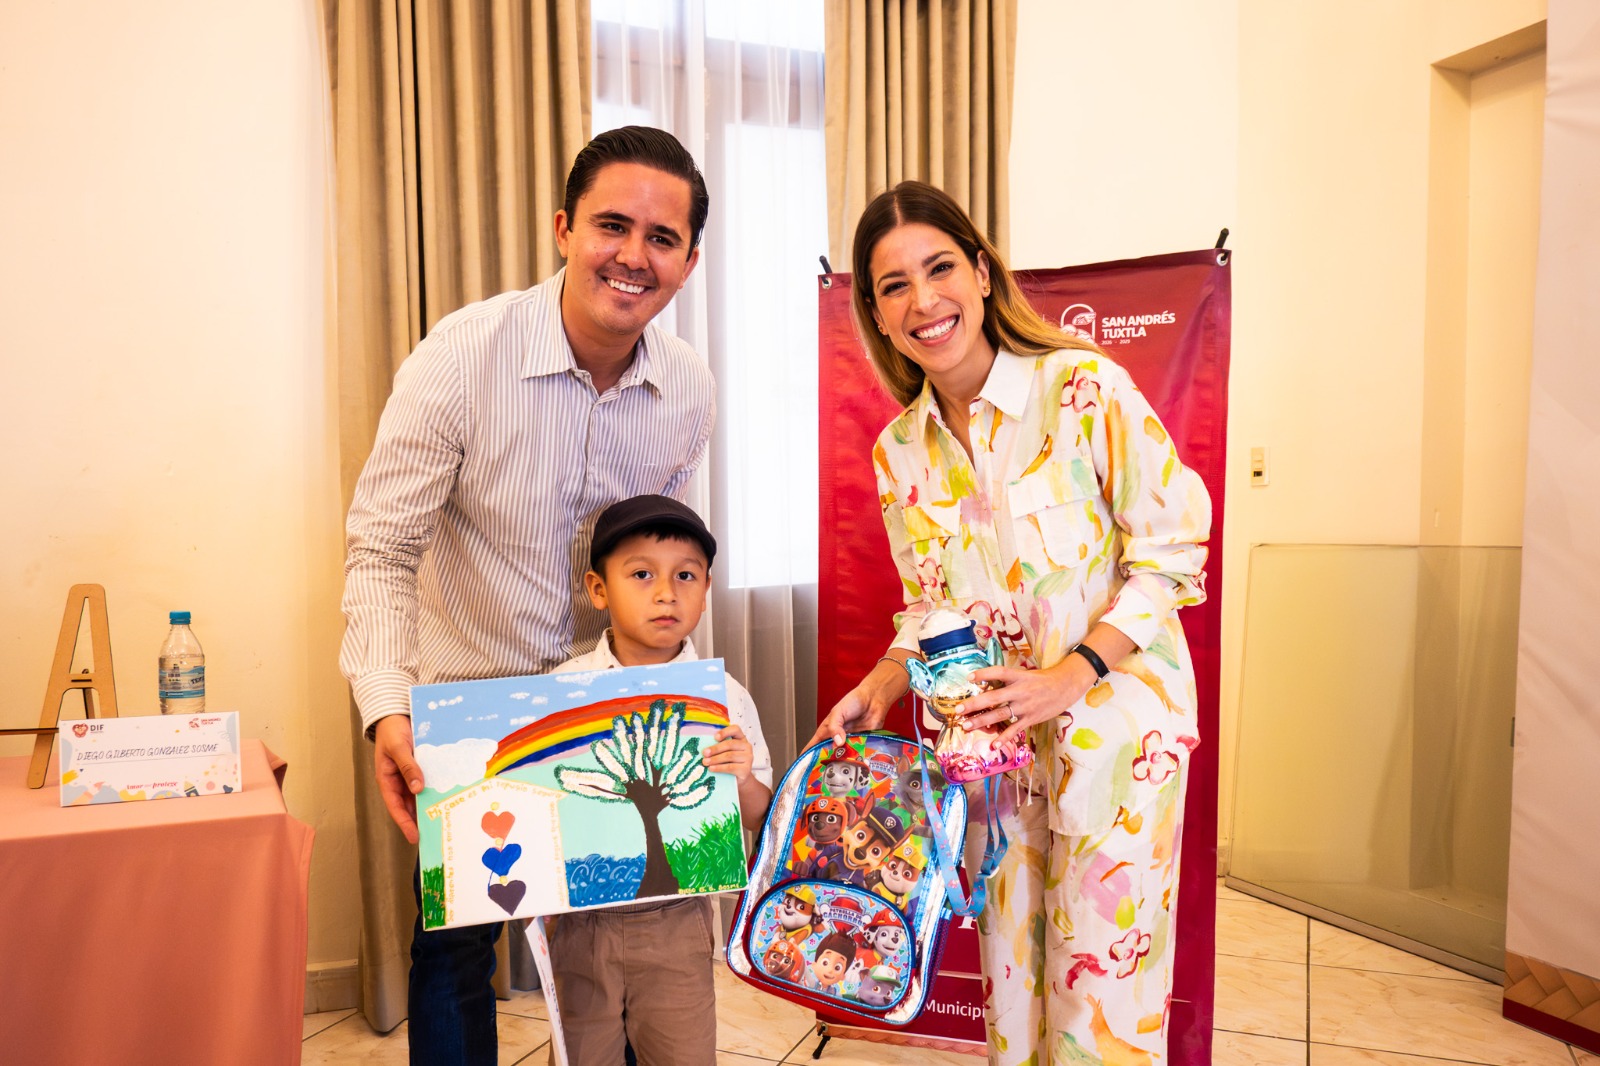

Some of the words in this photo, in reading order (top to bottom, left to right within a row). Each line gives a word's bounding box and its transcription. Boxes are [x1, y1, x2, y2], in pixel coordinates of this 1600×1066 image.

[1101, 316, 1126, 327] SAN
[1127, 310, 1176, 326] ANDRÉS
[1101, 326, 1147, 339] TUXTLA
[90, 724, 105, 732] DIF
[77, 750, 105, 761] DIEGO
[105, 748, 146, 760] GILBERTO
[147, 745, 190, 757] GONZALEZ
[191, 743, 217, 754] SOSME
[428, 804, 442, 819] Mi
